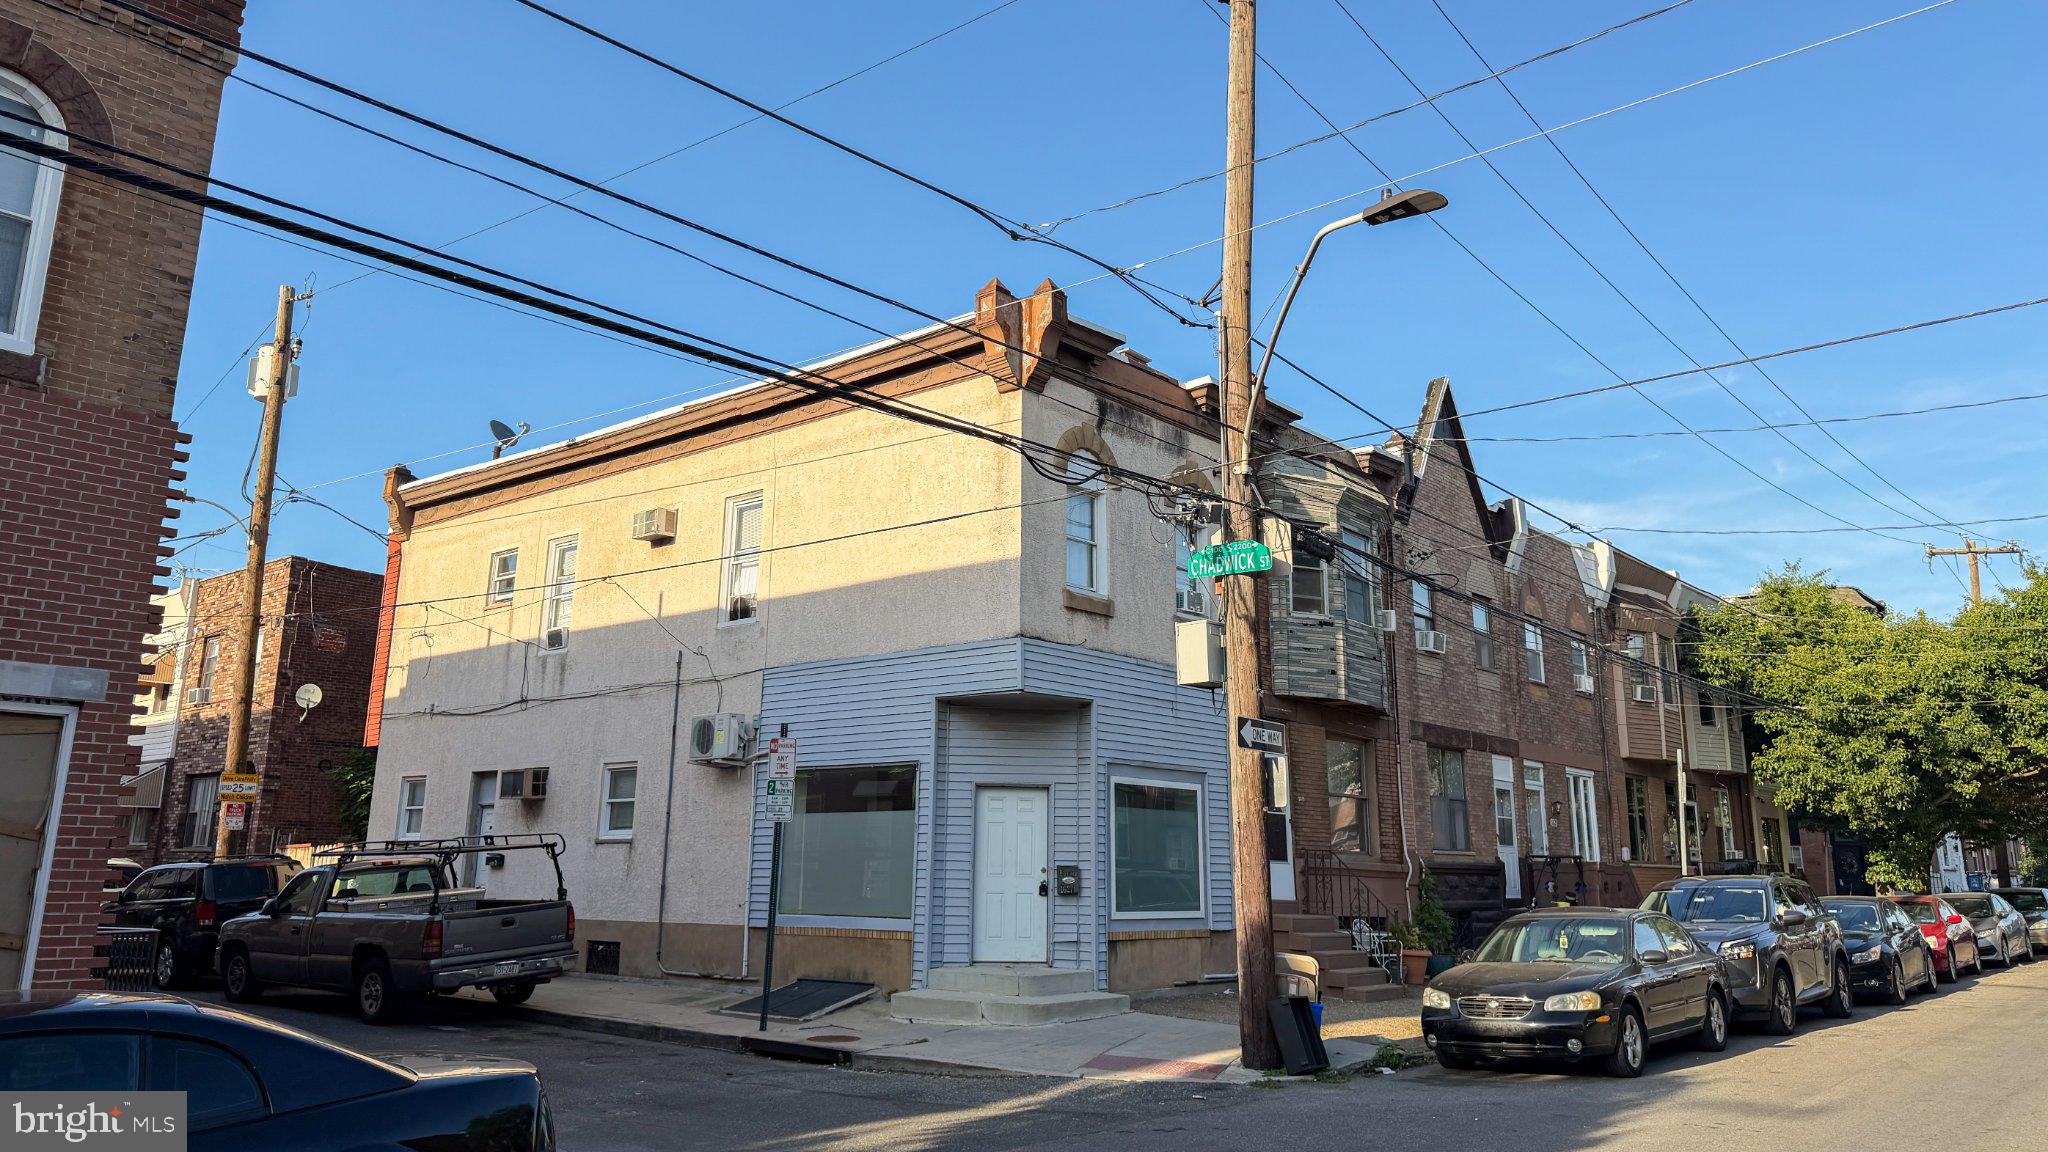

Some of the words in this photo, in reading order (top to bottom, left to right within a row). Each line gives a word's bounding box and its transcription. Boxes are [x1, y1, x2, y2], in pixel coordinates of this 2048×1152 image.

[1233, 543, 1252, 551] 2200
[1191, 552, 1256, 576] CHADWICK
[1260, 555, 1270, 568] ST
[1252, 728, 1266, 742] ONE
[1267, 730, 1280, 744] WAY
[232, 783, 244, 793] 25
[768, 782, 775, 794] 2
